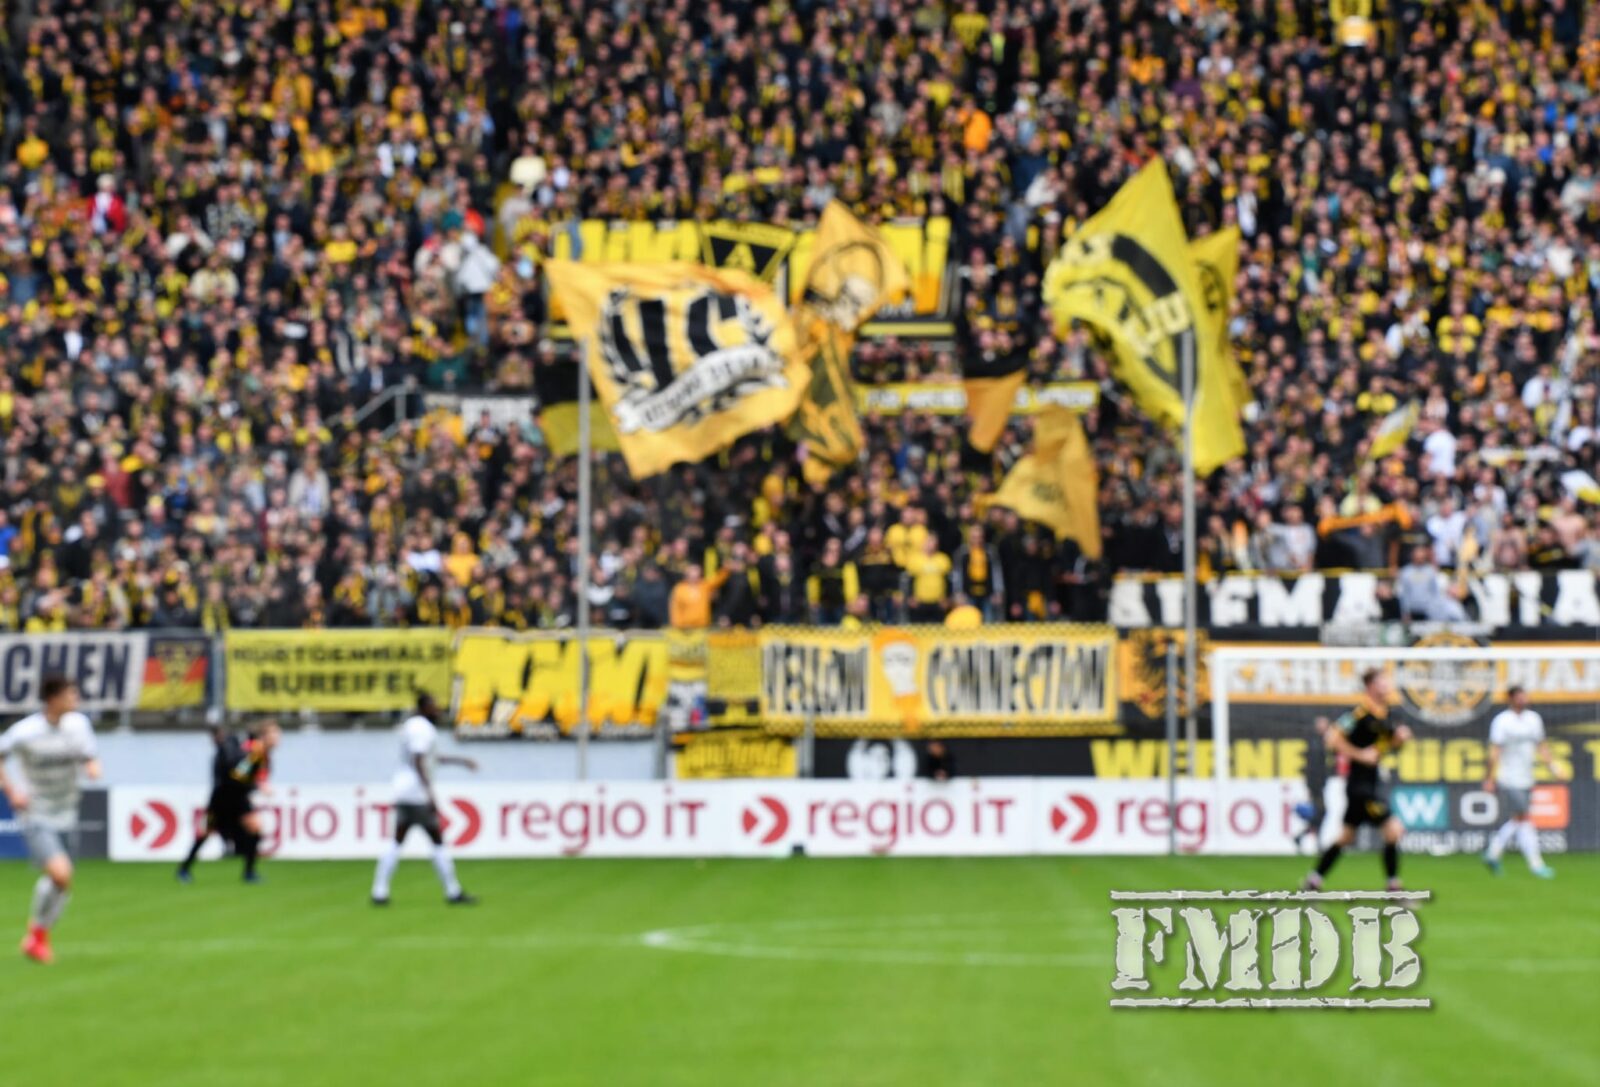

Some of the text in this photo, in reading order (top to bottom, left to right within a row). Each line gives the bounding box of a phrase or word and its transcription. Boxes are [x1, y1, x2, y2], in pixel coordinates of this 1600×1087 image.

[1107, 568, 1600, 629] ALEMANIA
[762, 642, 869, 716] YELLOW
[926, 641, 1108, 717] CONNECTION
[1090, 738, 1309, 778] WERNE
[193, 787, 340, 856] rgio
[500, 785, 706, 855] regio iT
[808, 781, 1014, 855] regio iT
[1117, 796, 1264, 854] rego
